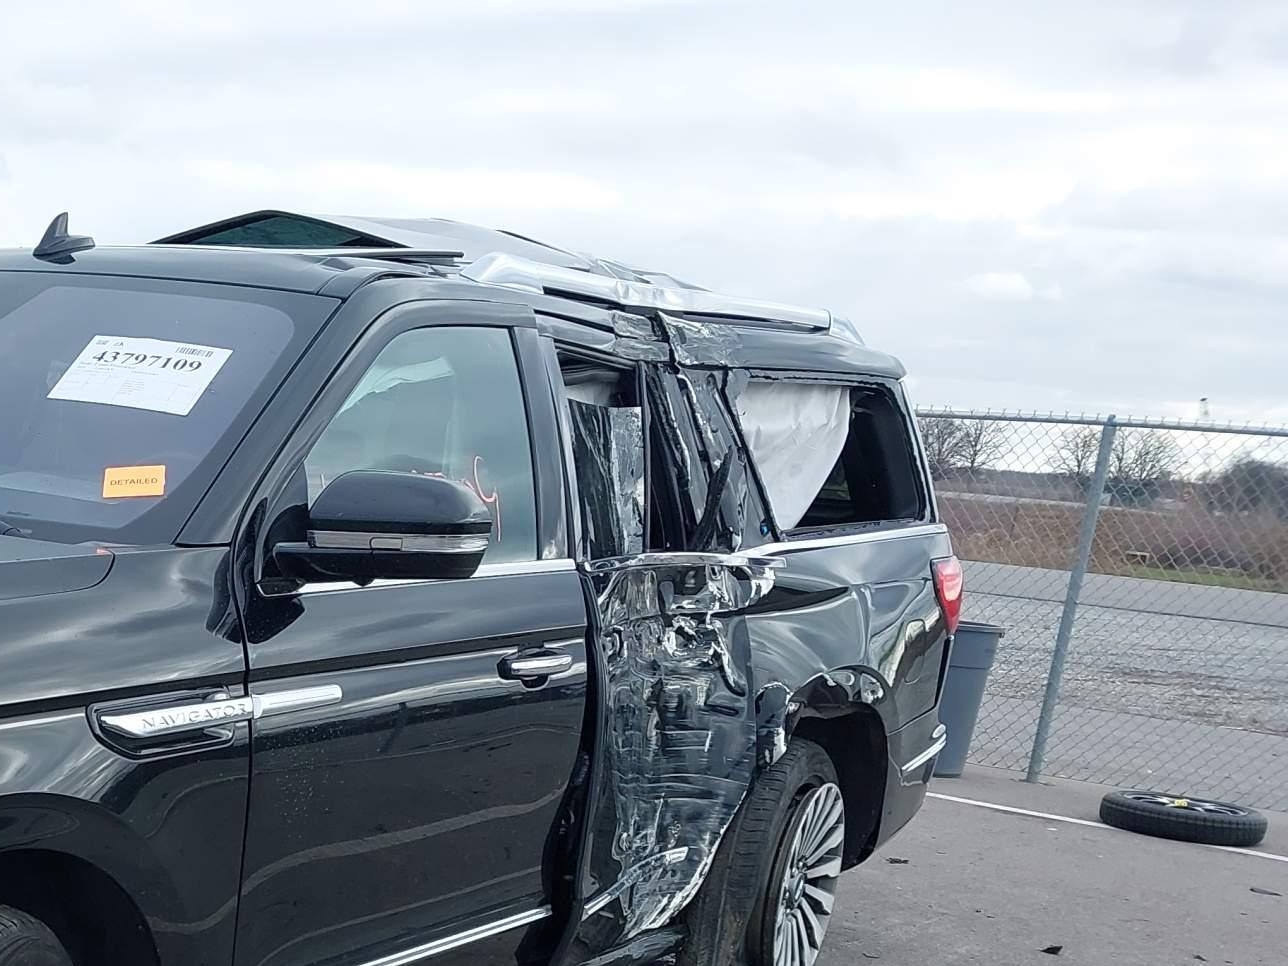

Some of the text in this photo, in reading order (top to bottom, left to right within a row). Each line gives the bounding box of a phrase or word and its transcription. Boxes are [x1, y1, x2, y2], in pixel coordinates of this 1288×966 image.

[92, 350, 202, 373] 43797109
[110, 477, 158, 486] DETAILED
[141, 703, 249, 729] NAVIGATOR
